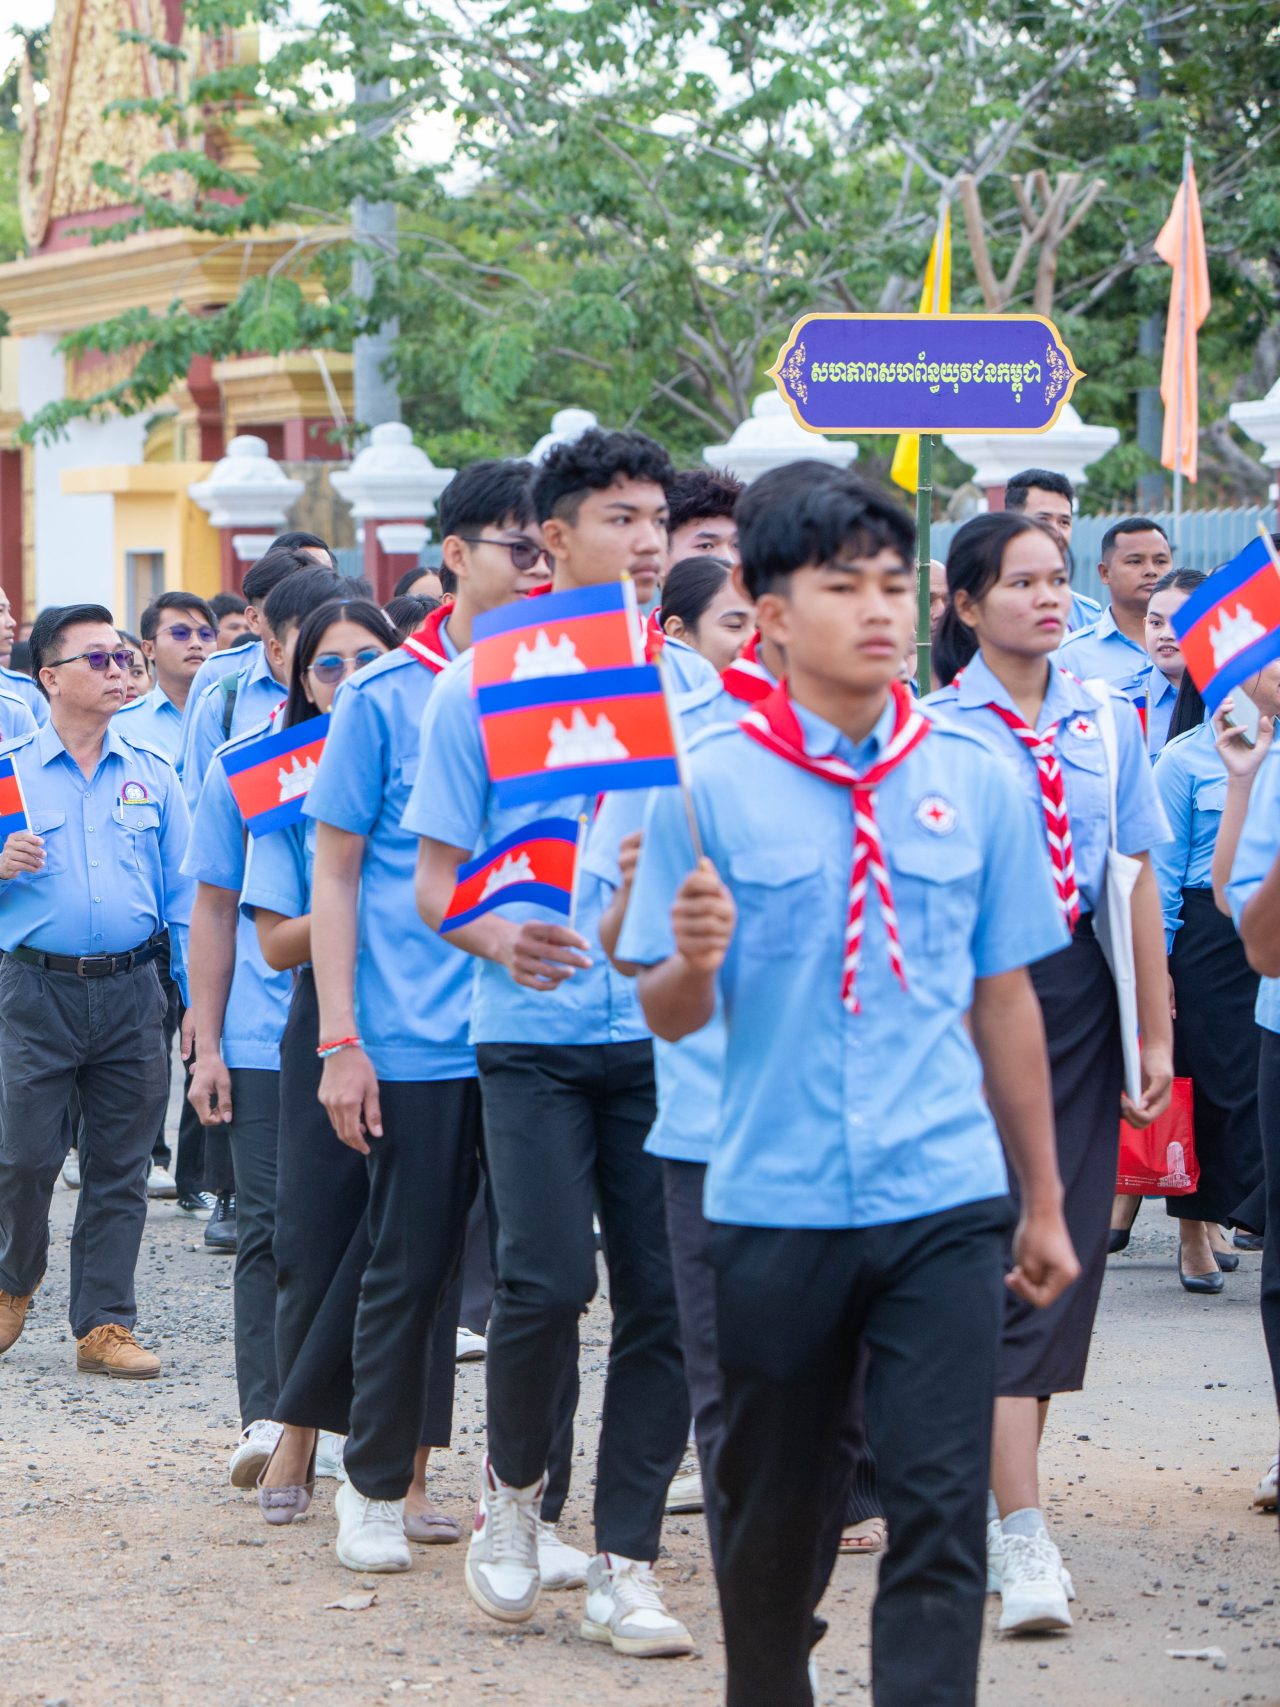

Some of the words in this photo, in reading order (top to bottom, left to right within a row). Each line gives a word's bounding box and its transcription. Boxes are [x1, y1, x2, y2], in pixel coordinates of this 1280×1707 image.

[811, 351, 1041, 403] សហភាពសហព័ន្ធយុវជនកម្ពុជា
